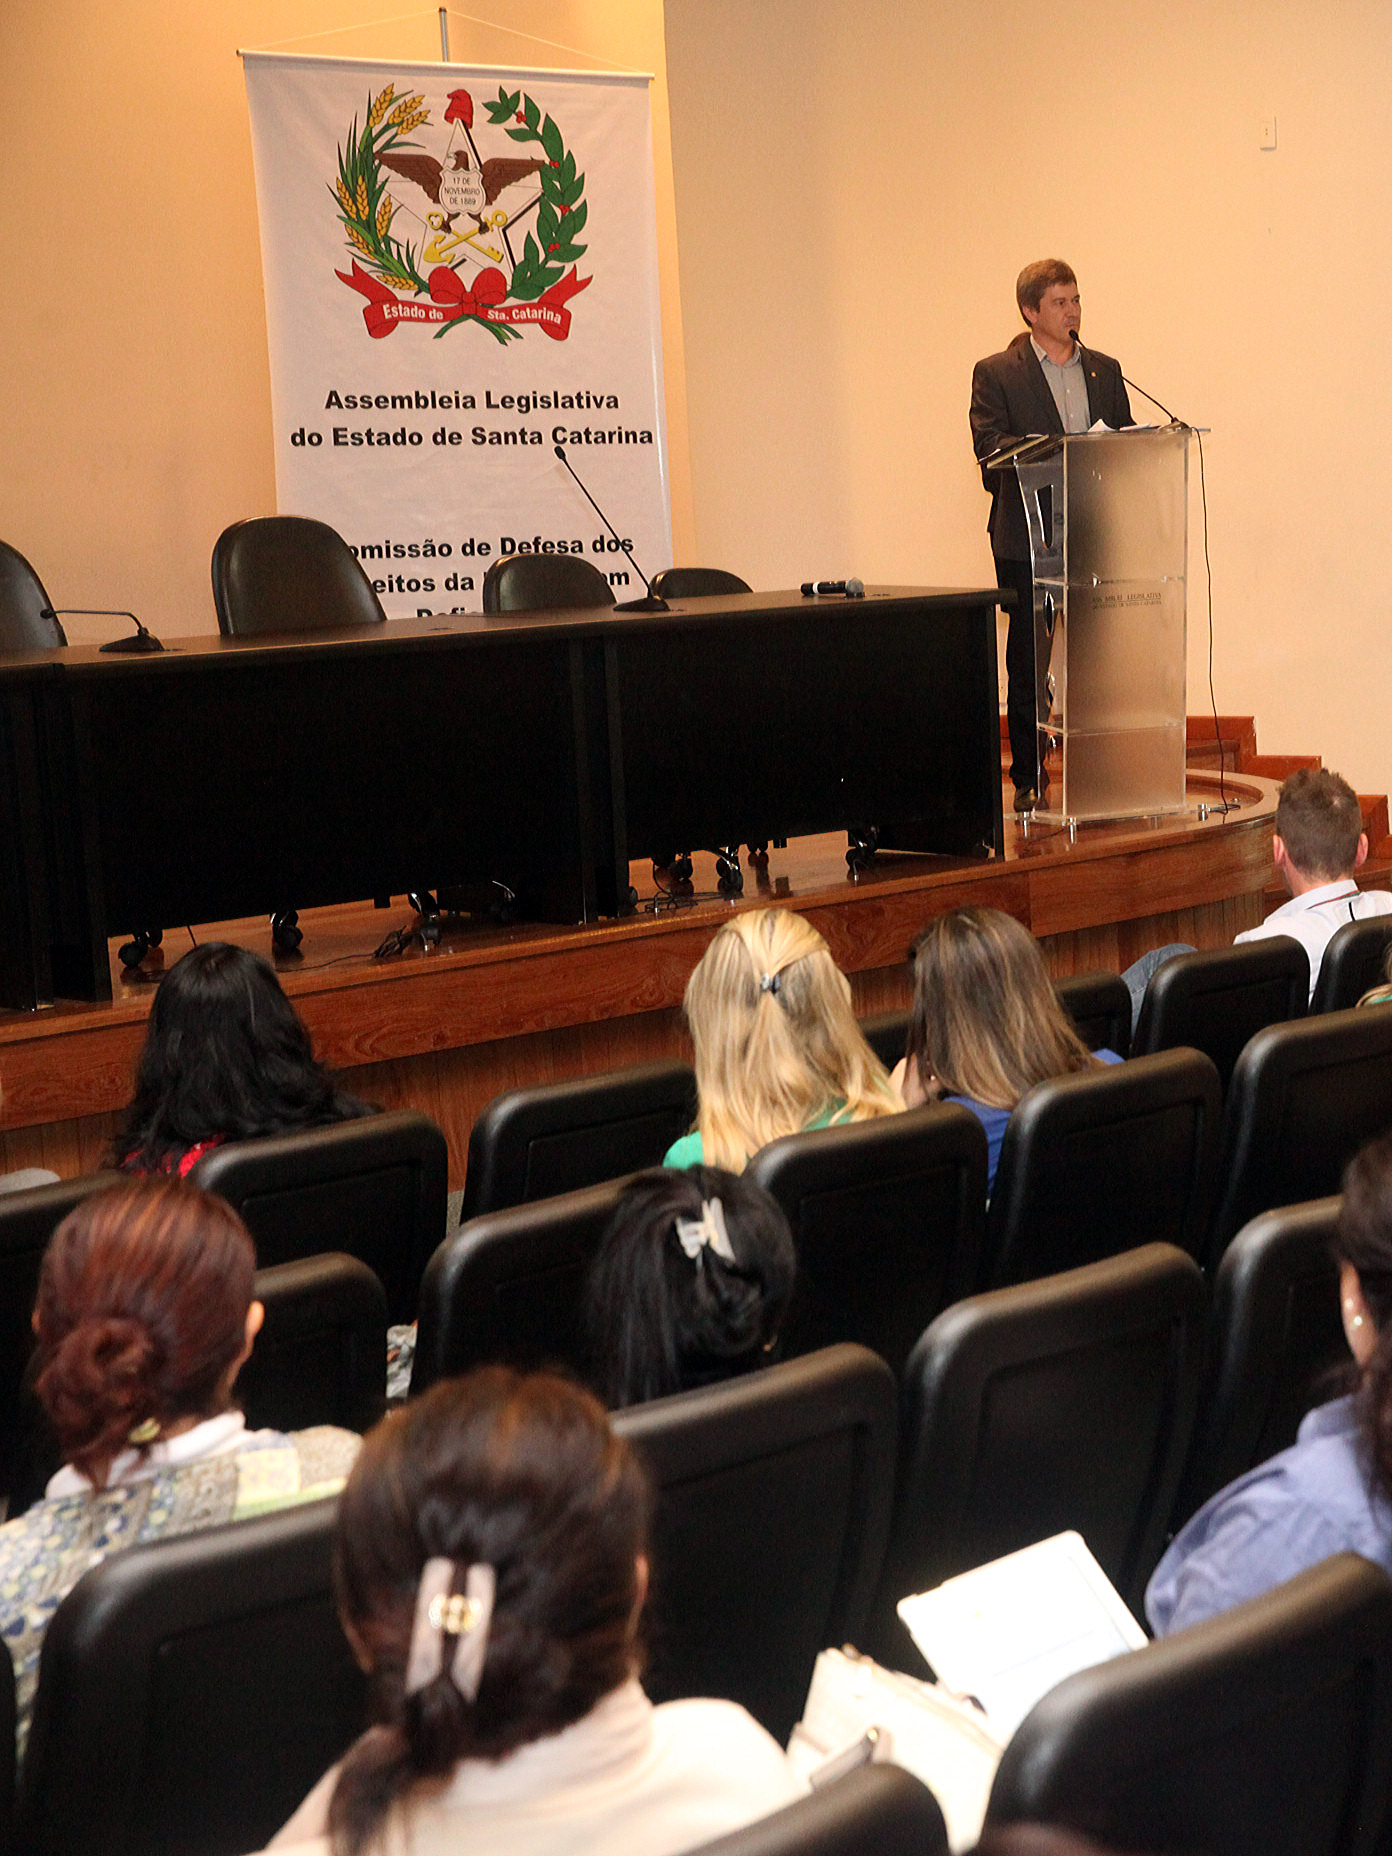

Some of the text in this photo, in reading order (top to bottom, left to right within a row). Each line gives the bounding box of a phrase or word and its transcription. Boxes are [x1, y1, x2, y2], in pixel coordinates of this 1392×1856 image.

[462, 177, 471, 185] DE
[444, 187, 481, 196] NOVEMBRO
[449, 197, 458, 205] DE
[382, 303, 444, 320] Estado de
[487, 307, 562, 325] Sta. Catarina
[324, 390, 619, 414] Assembleia Legislativa
[290, 426, 653, 447] do Estado de Santa Catarina
[349, 534, 634, 559] omissão de Defesa dos
[372, 574, 436, 593] eitos
[444, 572, 474, 591] da
